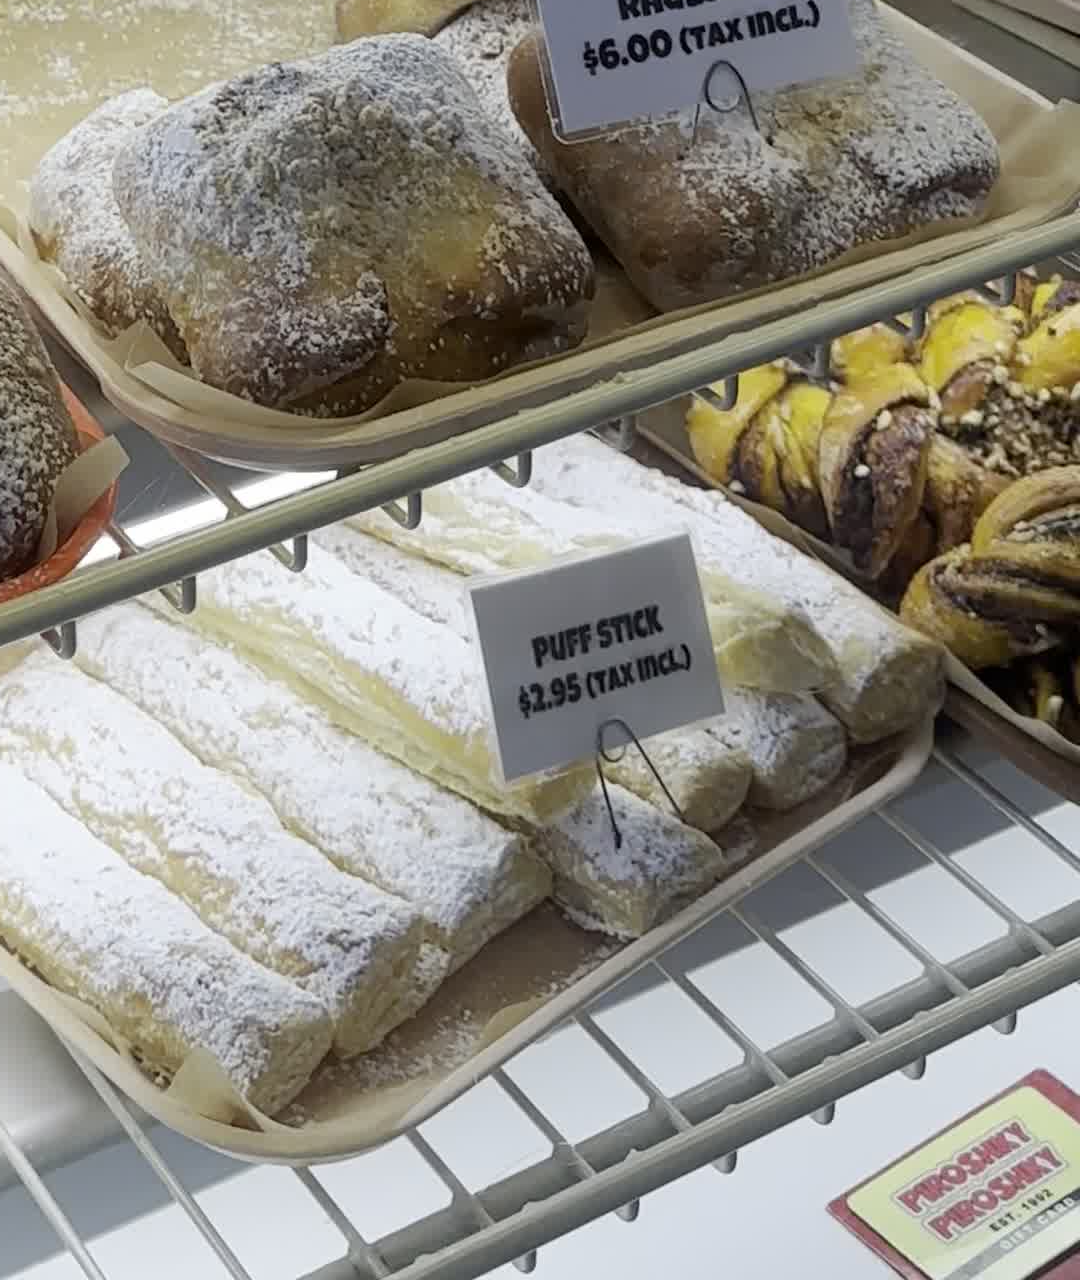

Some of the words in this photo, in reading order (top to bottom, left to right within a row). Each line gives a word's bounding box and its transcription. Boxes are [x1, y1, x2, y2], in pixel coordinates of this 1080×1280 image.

[583, 29, 674, 76] $6.00
[679, 17, 744, 55] (TAX
[531, 623, 592, 669] PUFF
[596, 604, 664, 648] STICK
[517, 672, 581, 719] $2.95
[586, 660, 636, 700] (TAX
